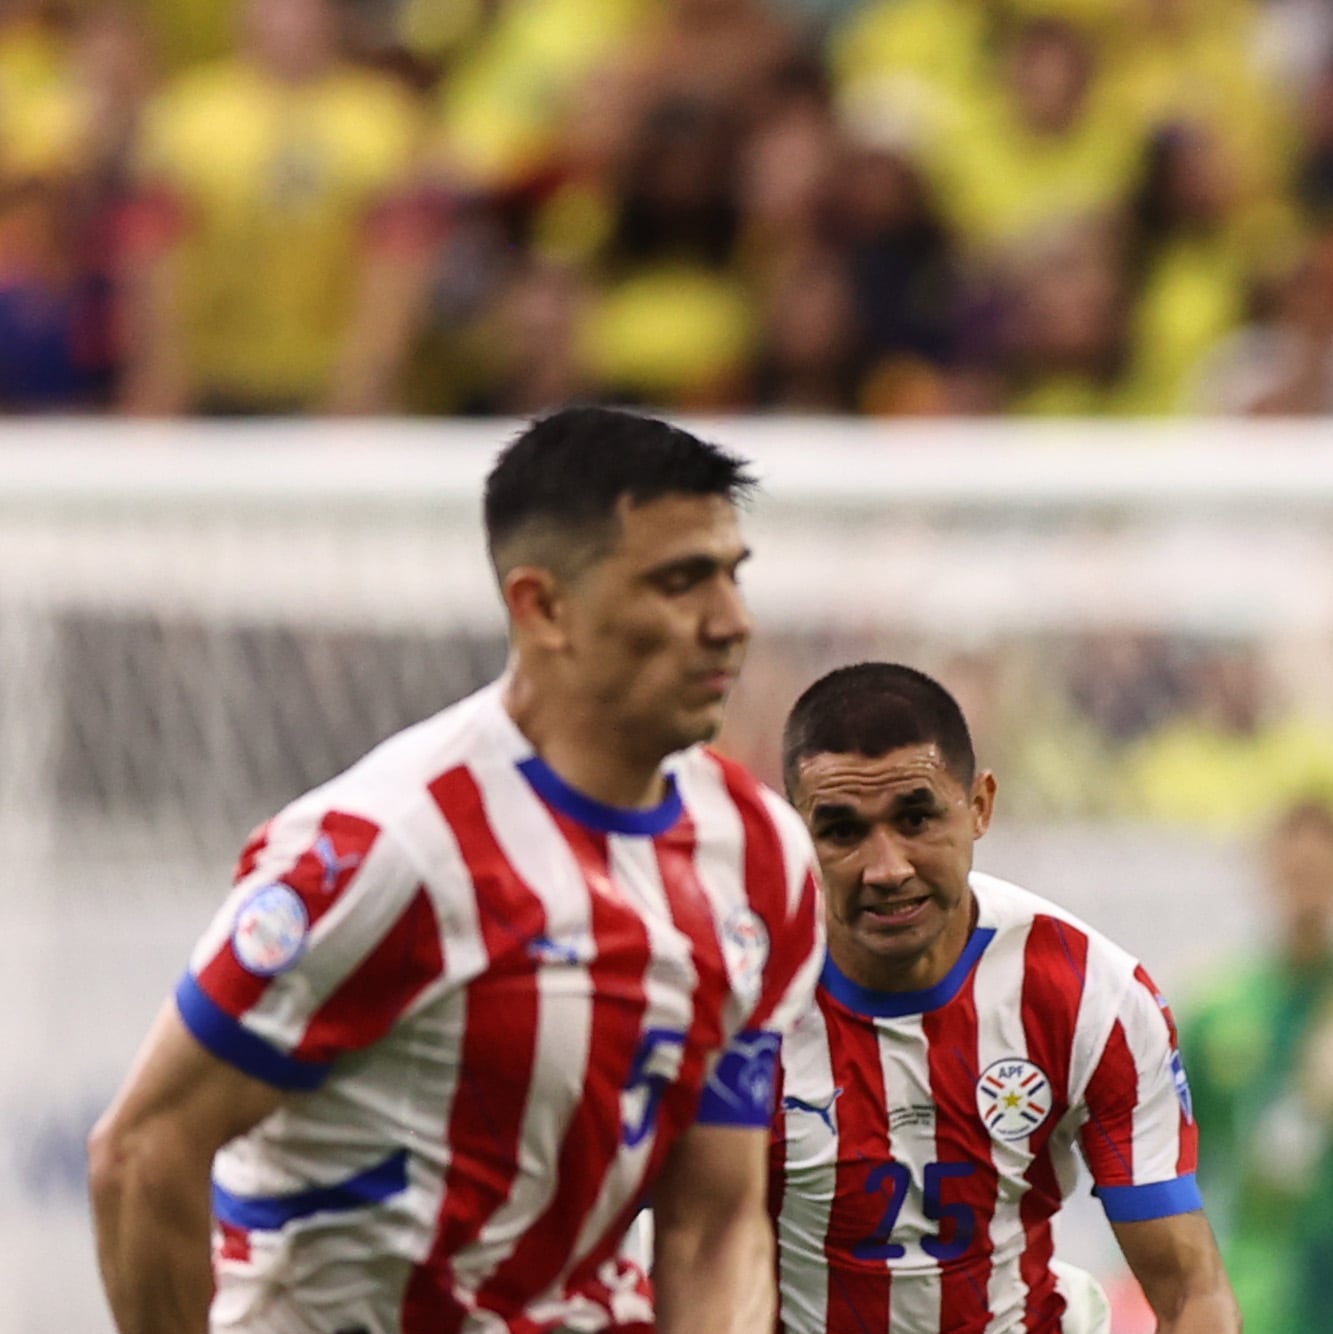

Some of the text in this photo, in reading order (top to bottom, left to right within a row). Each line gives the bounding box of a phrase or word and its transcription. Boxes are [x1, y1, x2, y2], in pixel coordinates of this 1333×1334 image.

[623, 1028, 687, 1147] 5
[998, 1065, 1024, 1079] APF
[851, 1162, 976, 1261] 25
